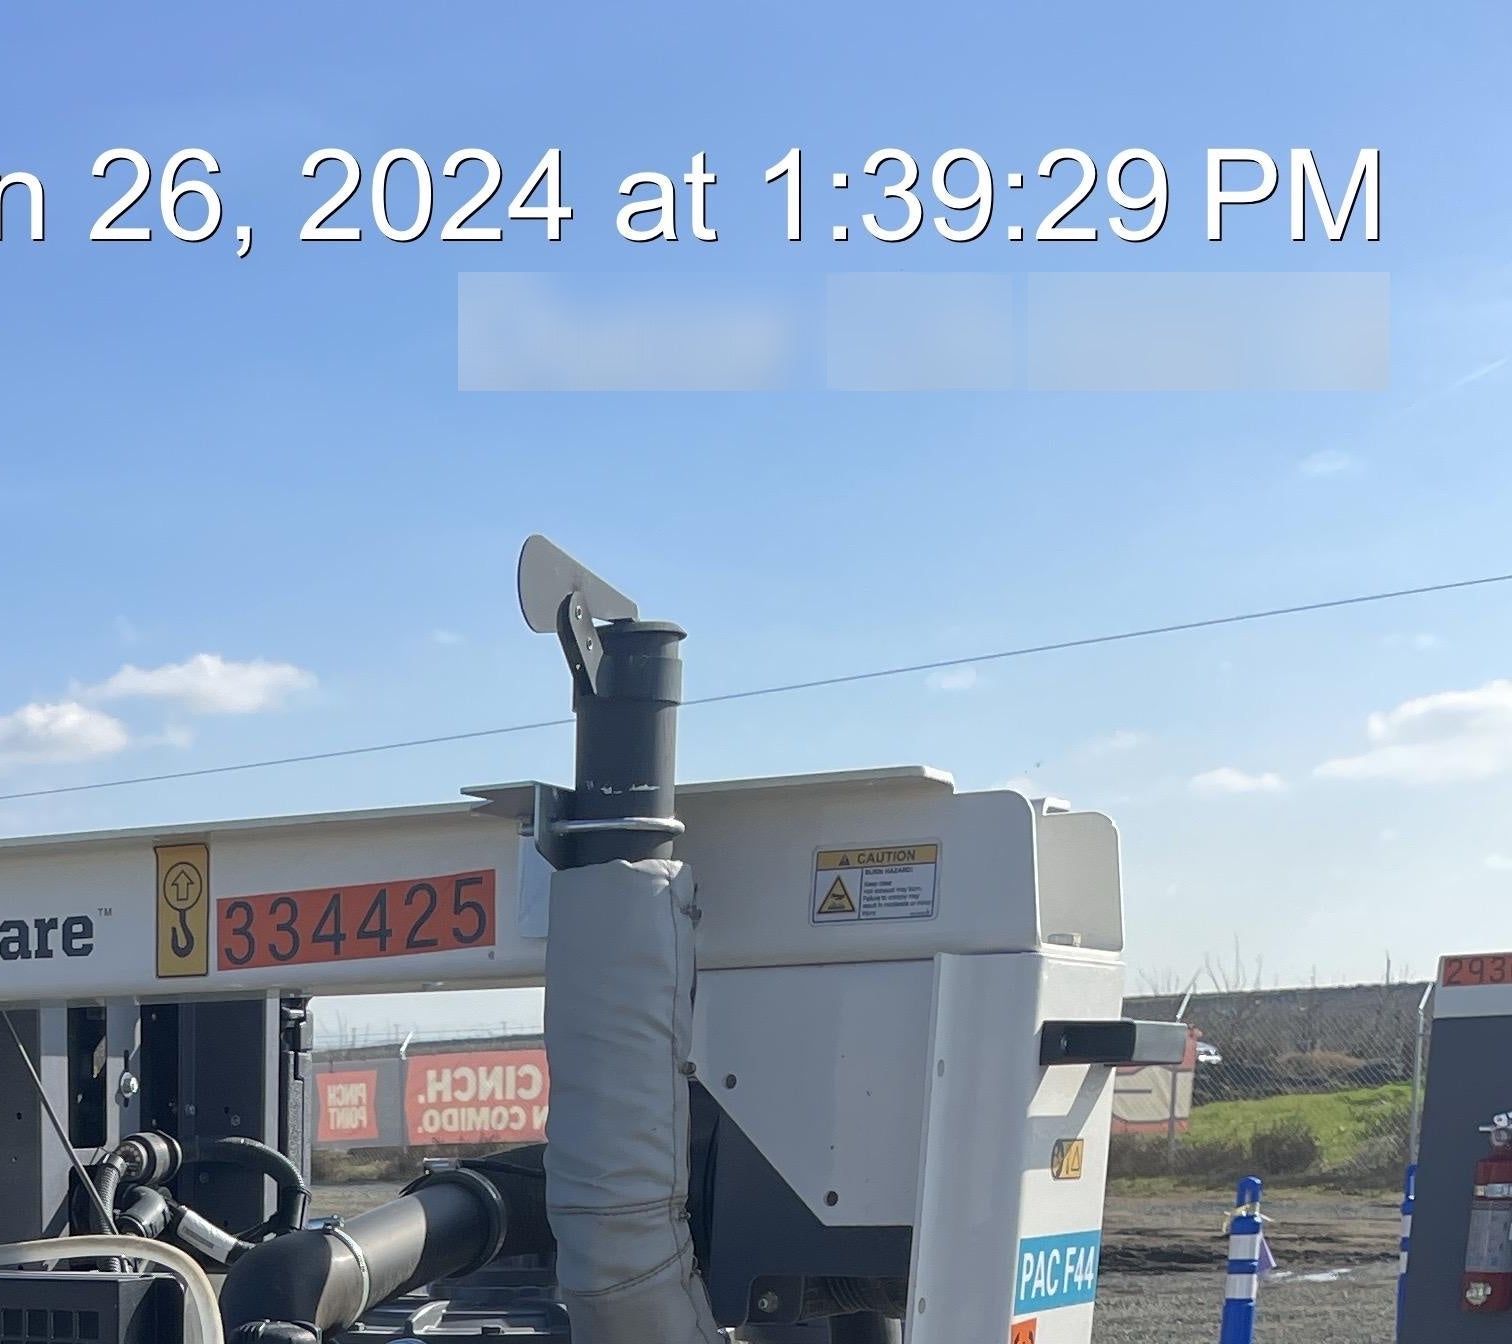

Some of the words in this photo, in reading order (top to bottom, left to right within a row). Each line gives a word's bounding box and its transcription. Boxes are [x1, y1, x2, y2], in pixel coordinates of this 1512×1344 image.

[857, 849, 917, 865] CAUTION
[224, 876, 487, 965] 334425
[1446, 956, 1512, 984] 293
[1020, 1251, 1060, 1301] PAC
[1064, 1246, 1095, 1294] F44
